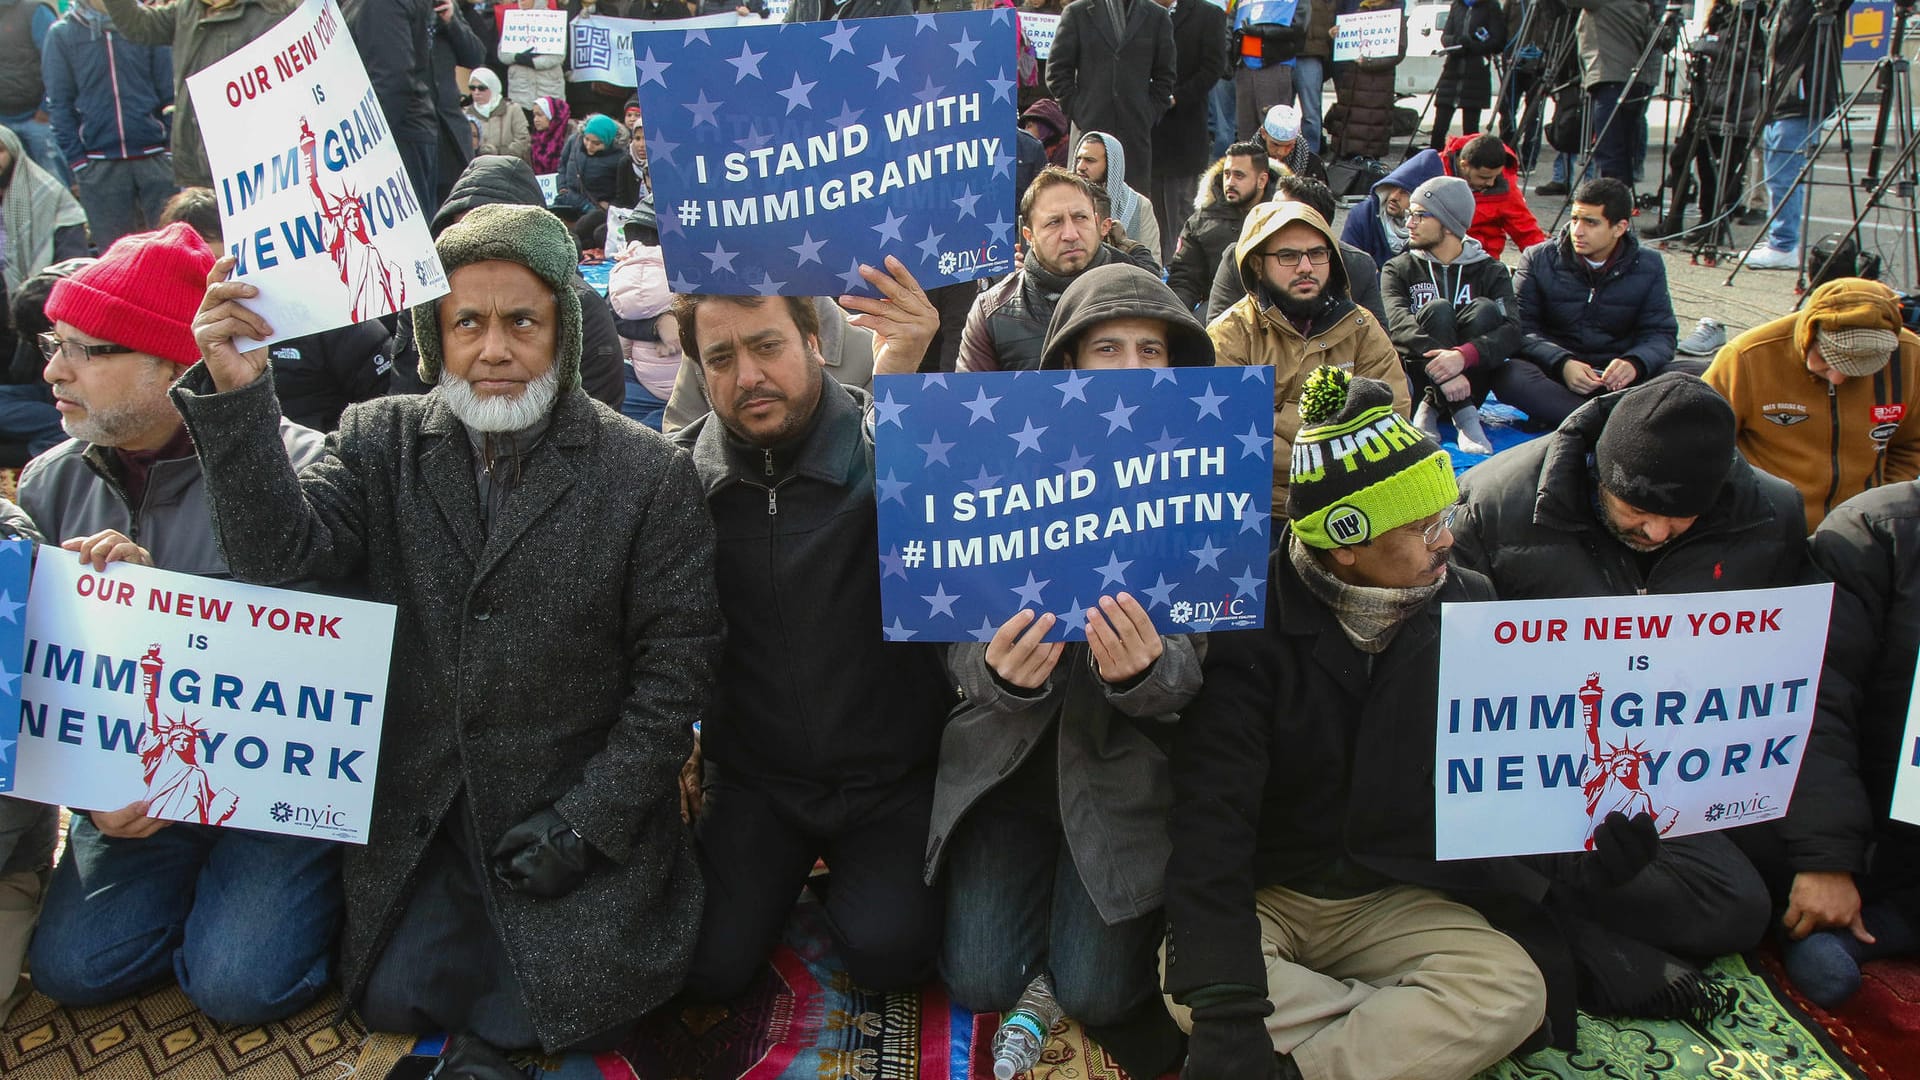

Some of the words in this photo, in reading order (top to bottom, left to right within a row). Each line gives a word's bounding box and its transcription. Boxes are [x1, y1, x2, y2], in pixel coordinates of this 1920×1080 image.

[226, 65, 272, 108] OUR
[273, 31, 318, 82] NEW
[313, 0, 338, 50] YORK
[1025, 29, 1055, 38] GRAN
[1031, 41, 1051, 49] YOR
[1336, 26, 1397, 39] IMMIGRANT
[1336, 40, 1361, 50] NEW
[1368, 38, 1396, 46] YORK
[311, 84, 326, 105] IS
[222, 86, 387, 217] IMMIGRANT
[695, 155, 707, 184] I
[725, 123, 869, 183] STAND
[884, 92, 981, 143] WITH
[677, 137, 1001, 228] #IMMIGRANTNY
[228, 211, 328, 281] NEW
[359, 166, 418, 237] YORK
[958, 240, 998, 273] nyic
[1455, 283, 1472, 305] A
[1329, 412, 1425, 473] YORK
[924, 494, 935, 524] I
[953, 467, 1096, 522] STAND
[1113, 446, 1225, 490] WITH
[902, 492, 1251, 570] #IMMIGRANTNY
[76, 574, 136, 607] OUR
[148, 588, 233, 623] NEW
[246, 604, 344, 640] YORK
[1194, 593, 1244, 625] nyic
[1493, 618, 1568, 645] OUR
[1583, 615, 1673, 641] NEW
[1687, 608, 1784, 637] YORK
[187, 633, 209, 651] IS
[1627, 655, 1650, 672] IS
[23, 638, 374, 727] IMMIGRANT
[1449, 678, 1809, 734] IMMIGRANT
[19, 698, 147, 755] NEW
[197, 731, 367, 784] YORK
[1447, 753, 1589, 795] NEW
[1644, 734, 1798, 786] YORK
[295, 804, 346, 830] nyic
[1726, 792, 1770, 820] nyic
